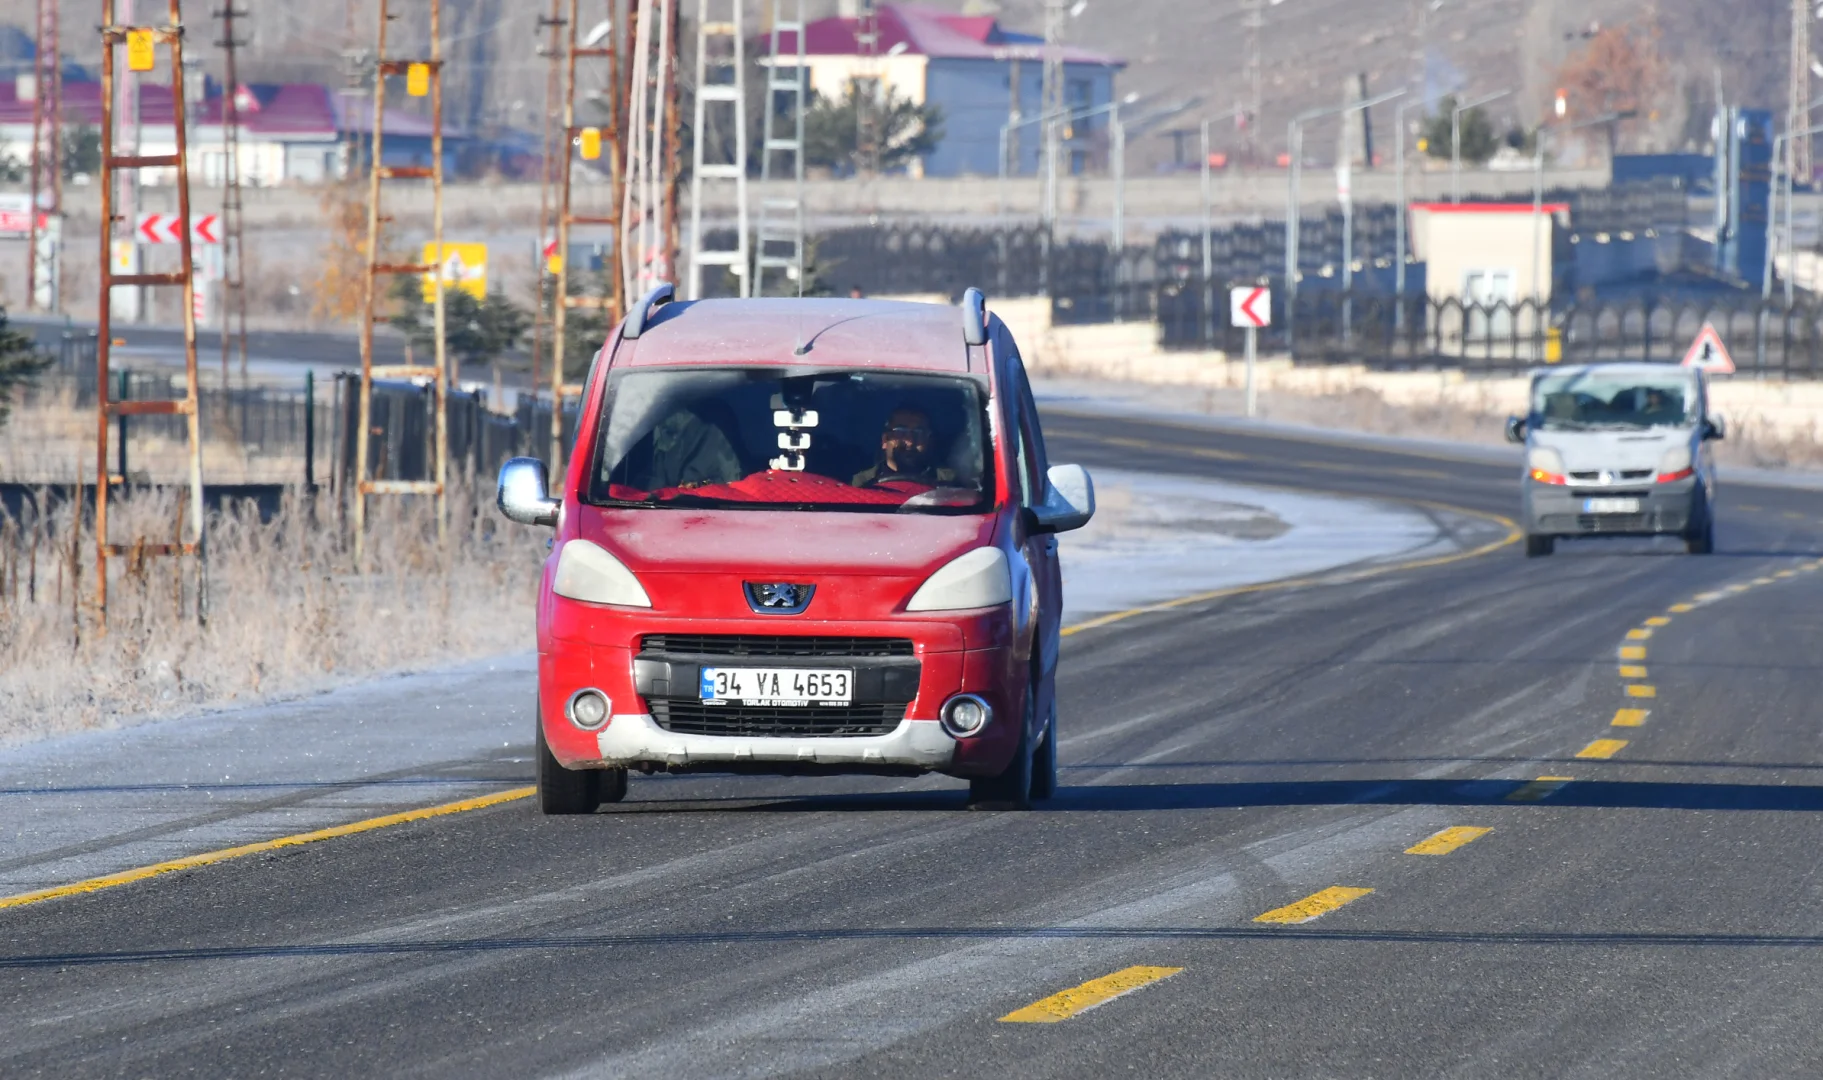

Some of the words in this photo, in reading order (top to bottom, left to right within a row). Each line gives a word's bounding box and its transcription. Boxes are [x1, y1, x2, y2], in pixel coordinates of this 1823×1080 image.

[704, 685, 714, 693] TR
[716, 672, 741, 695] 34
[794, 673, 847, 696] 4653
